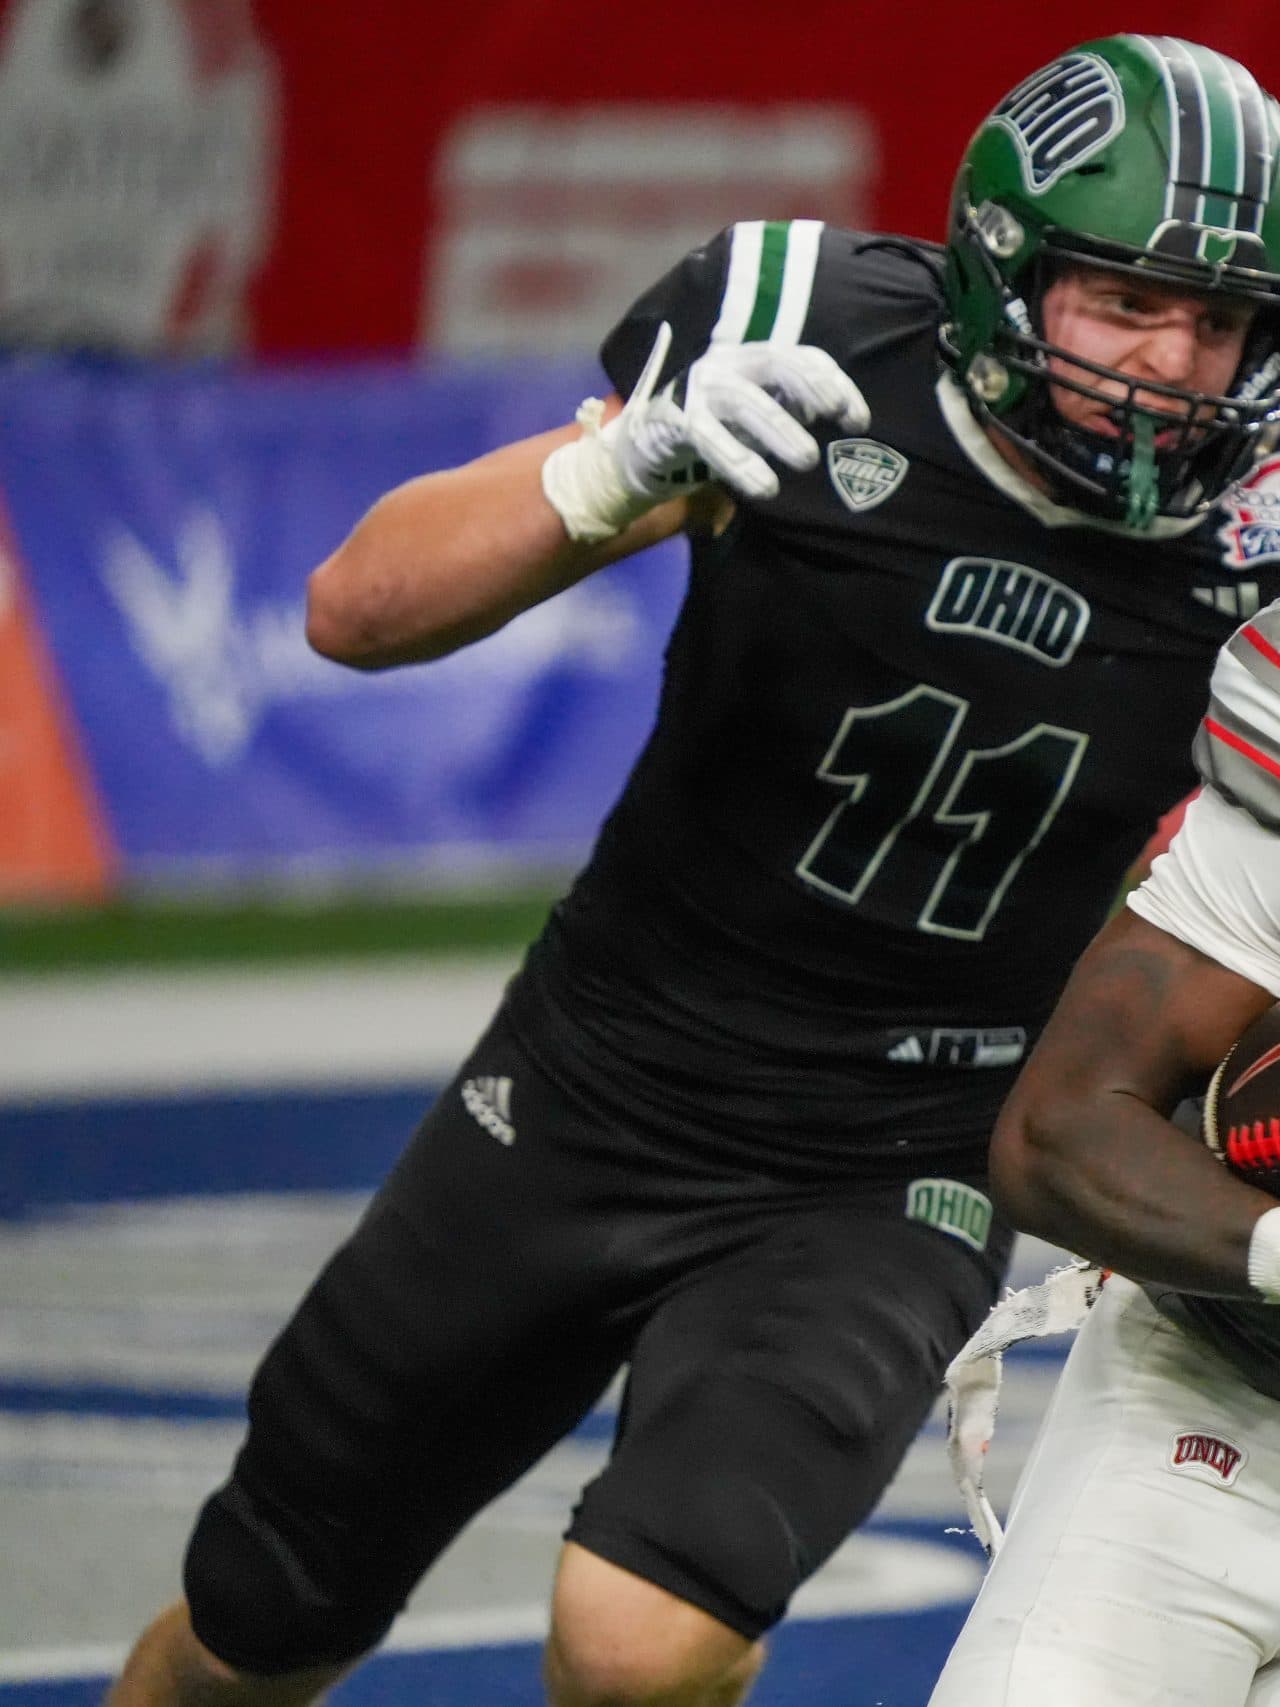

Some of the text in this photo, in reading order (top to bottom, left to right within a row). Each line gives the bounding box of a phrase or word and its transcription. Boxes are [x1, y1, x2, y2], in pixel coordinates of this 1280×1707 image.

[982, 52, 1126, 196] OHIO
[926, 556, 1091, 668] OHIO
[796, 683, 1090, 942] 11
[905, 1178, 993, 1251] OHIO
[1174, 1434, 1242, 1479] UNLV
